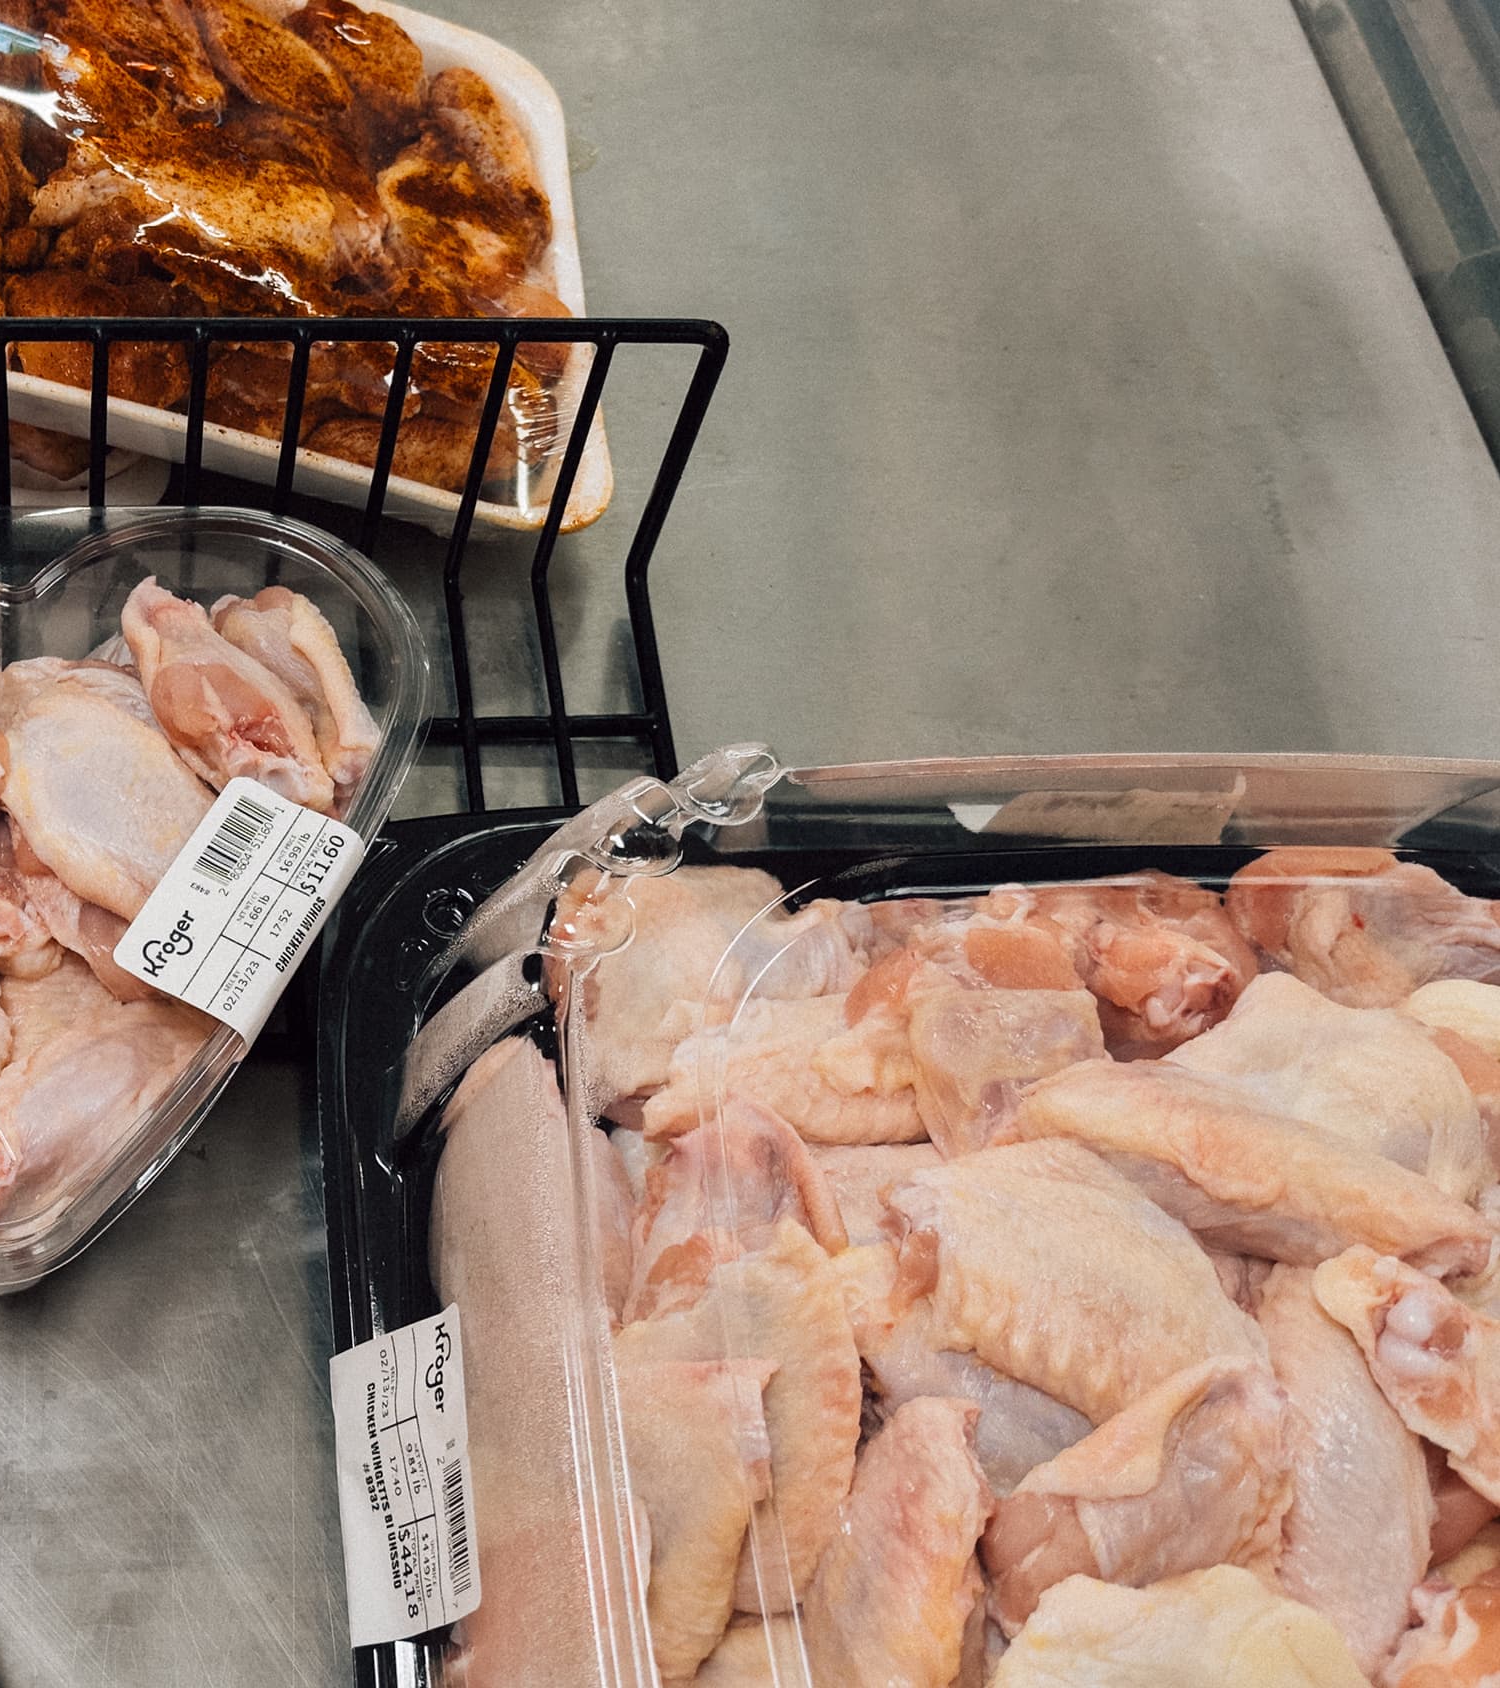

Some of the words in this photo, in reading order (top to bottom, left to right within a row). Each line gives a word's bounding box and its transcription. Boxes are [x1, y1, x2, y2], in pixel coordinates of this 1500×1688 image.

[229, 854, 252, 881] 80604
[252, 822, 274, 850] 51160
[300, 834, 345, 896] $11.60
[257, 893, 270, 908] lb
[143, 910, 195, 977] Kroger
[276, 928, 307, 974] CHICKEN
[301, 896, 327, 933] WINGS
[222, 960, 260, 1012] 02/13/23
[379, 1349, 390, 1418] 02/13/23
[426, 1322, 451, 1413] Kroger
[366, 1382, 378, 1439] CHICKEN
[370, 1441, 390, 1511] WINGETTS
[412, 1479, 421, 1495] lb
[385, 1514, 394, 1530] BI
[399, 1529, 419, 1618] $44.18
